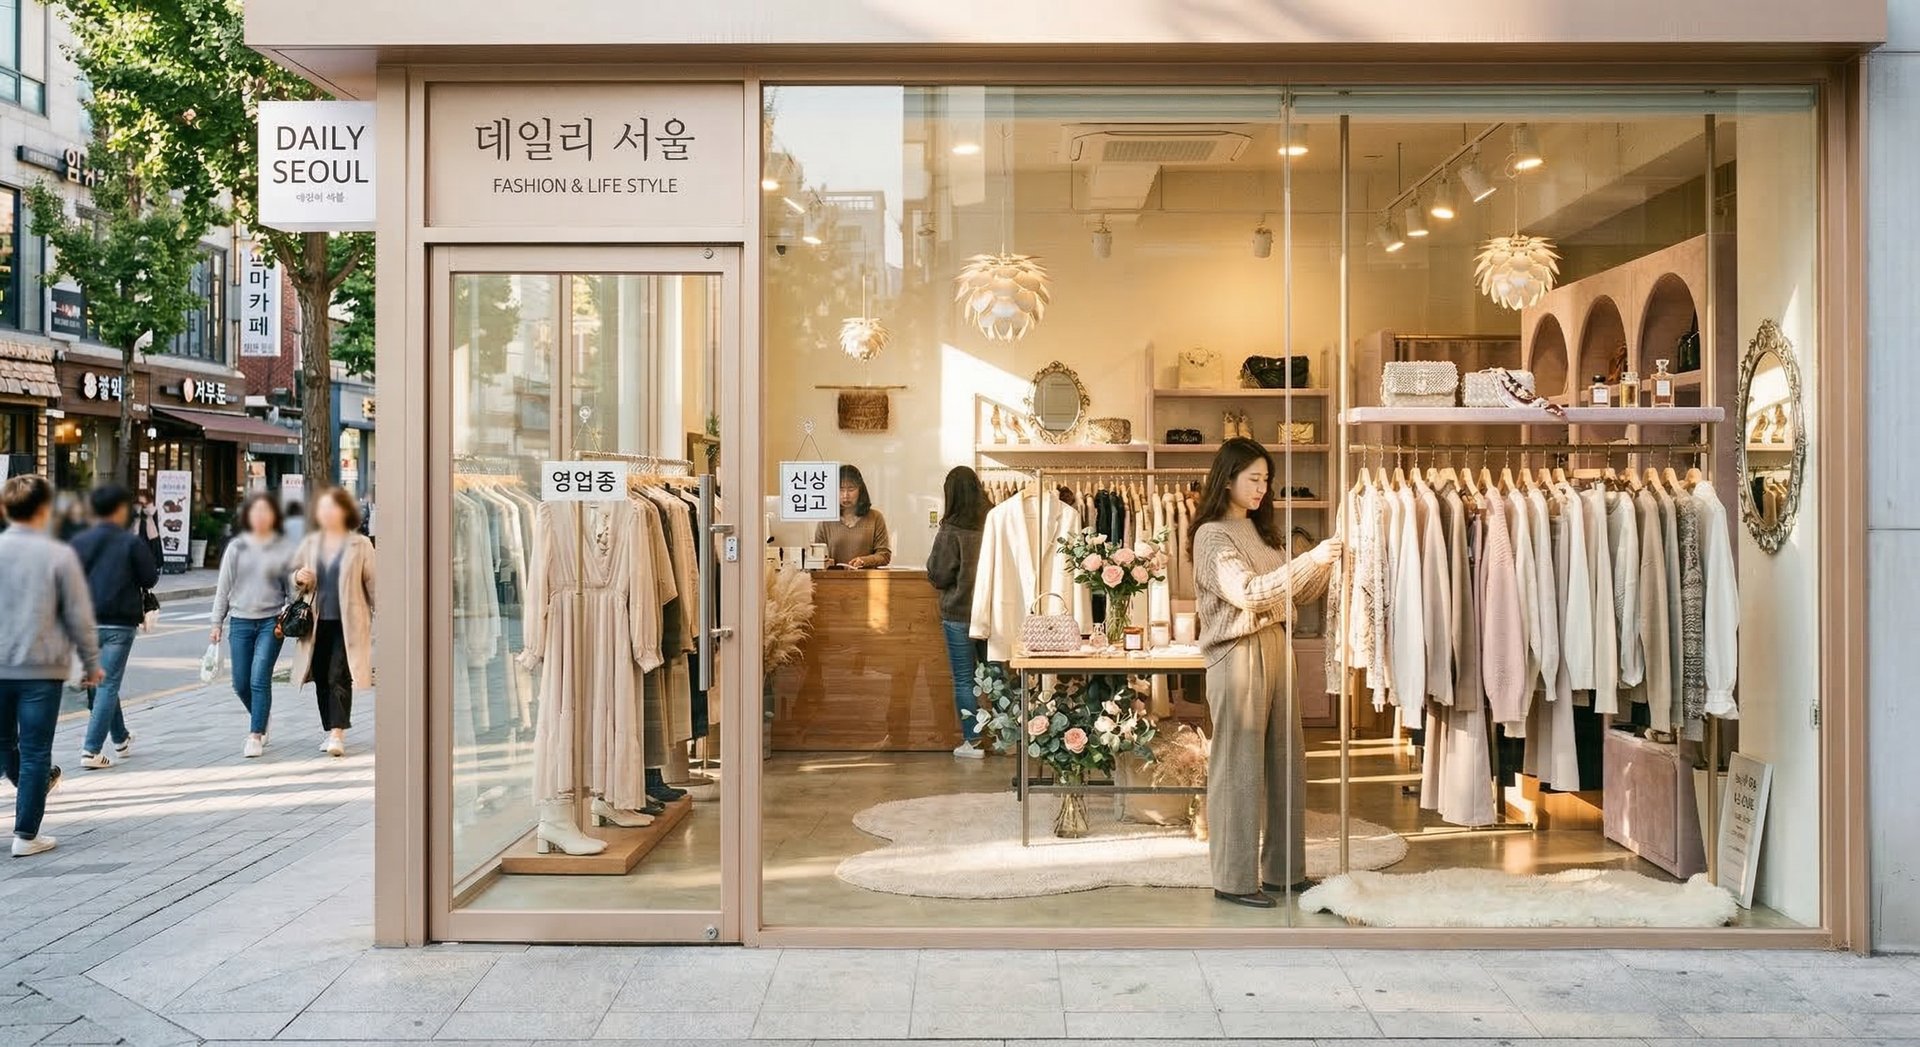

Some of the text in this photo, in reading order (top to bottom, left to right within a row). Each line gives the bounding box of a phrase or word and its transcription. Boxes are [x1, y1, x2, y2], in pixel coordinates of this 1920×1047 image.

[277, 126, 365, 150] DAILY
[475, 117, 696, 162] 데일리 서울
[273, 160, 369, 184] SEOUL
[493, 178, 678, 194] FASHION & LIFE STYLE
[553, 470, 616, 492] 영업종
[791, 470, 828, 490] 신상
[791, 494, 828, 512] 입고
